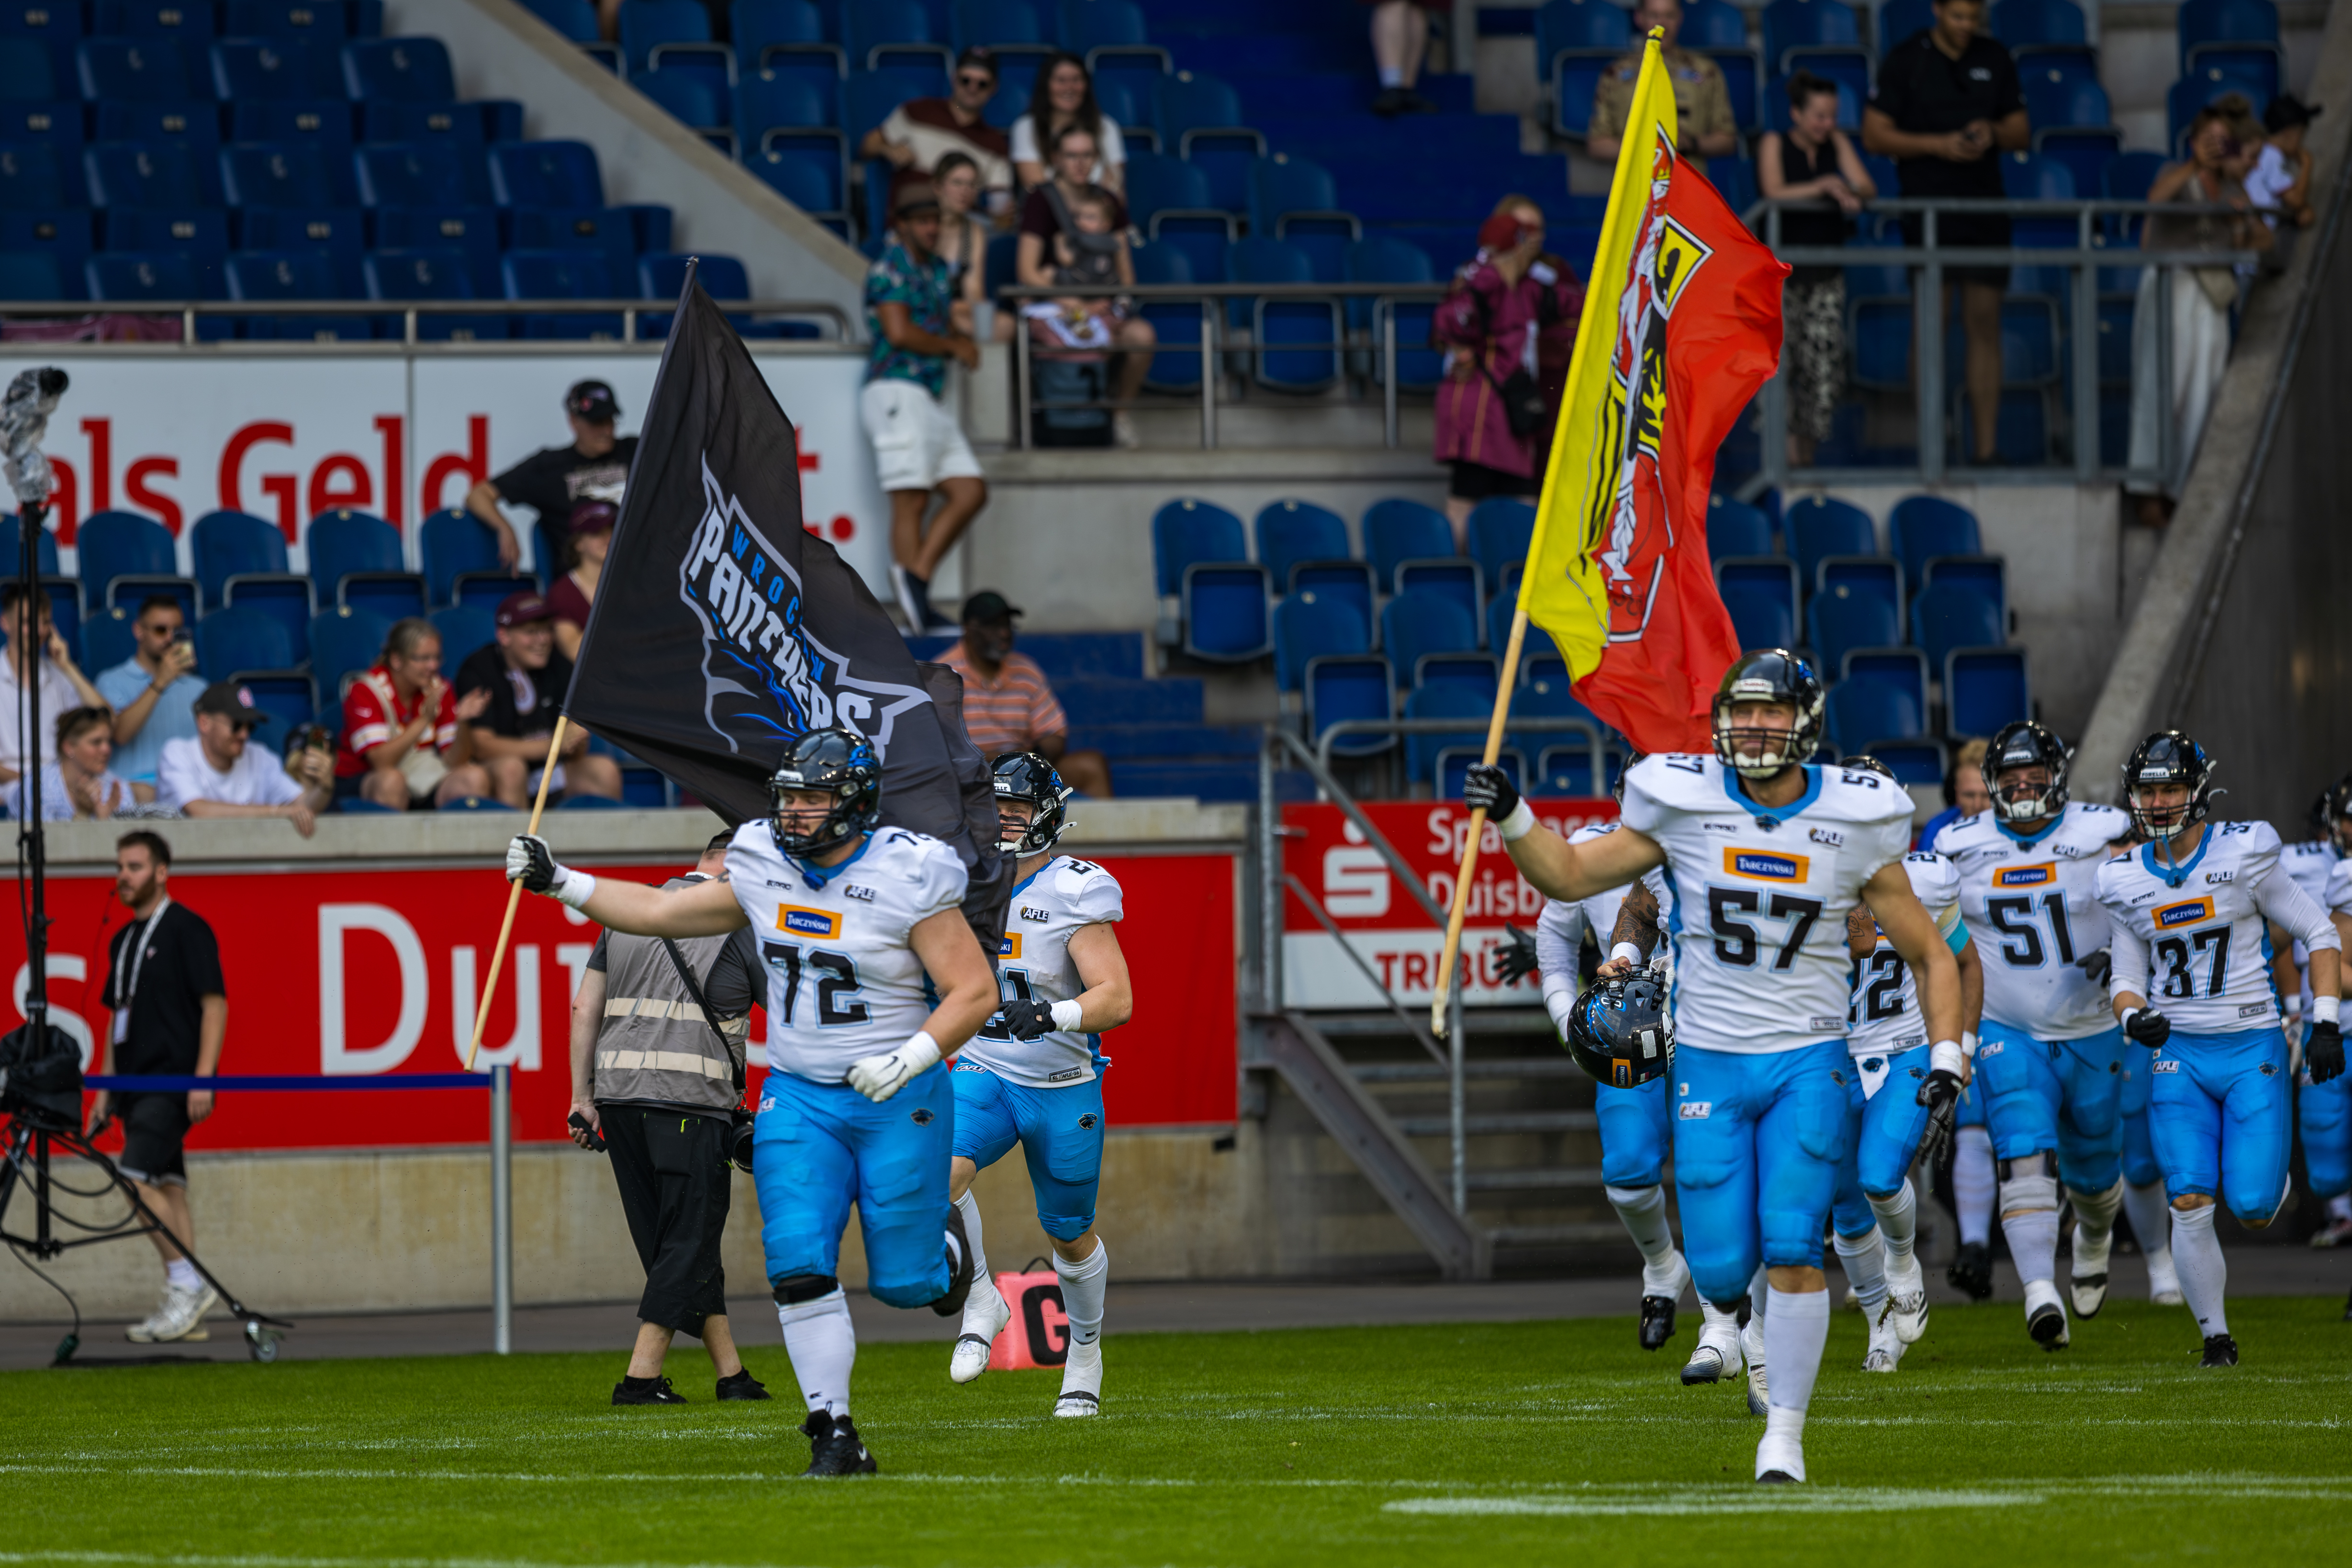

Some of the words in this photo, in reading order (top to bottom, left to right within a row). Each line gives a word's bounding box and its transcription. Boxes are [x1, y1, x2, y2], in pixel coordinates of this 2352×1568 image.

[215, 412, 490, 548] Geld
[846, 886, 875, 901] AFLE
[1023, 908, 1049, 921] AFLE
[2162, 907, 2204, 923] TARCZYŃSKI
[2209, 871, 2232, 884] AFLE
[1706, 884, 1825, 972] 57
[1986, 891, 2076, 968] 51
[2155, 923, 2232, 998] 37
[762, 940, 872, 1028] 72
[2156, 1061, 2178, 1072] AFLE
[1021, 1285, 1071, 1367] G
